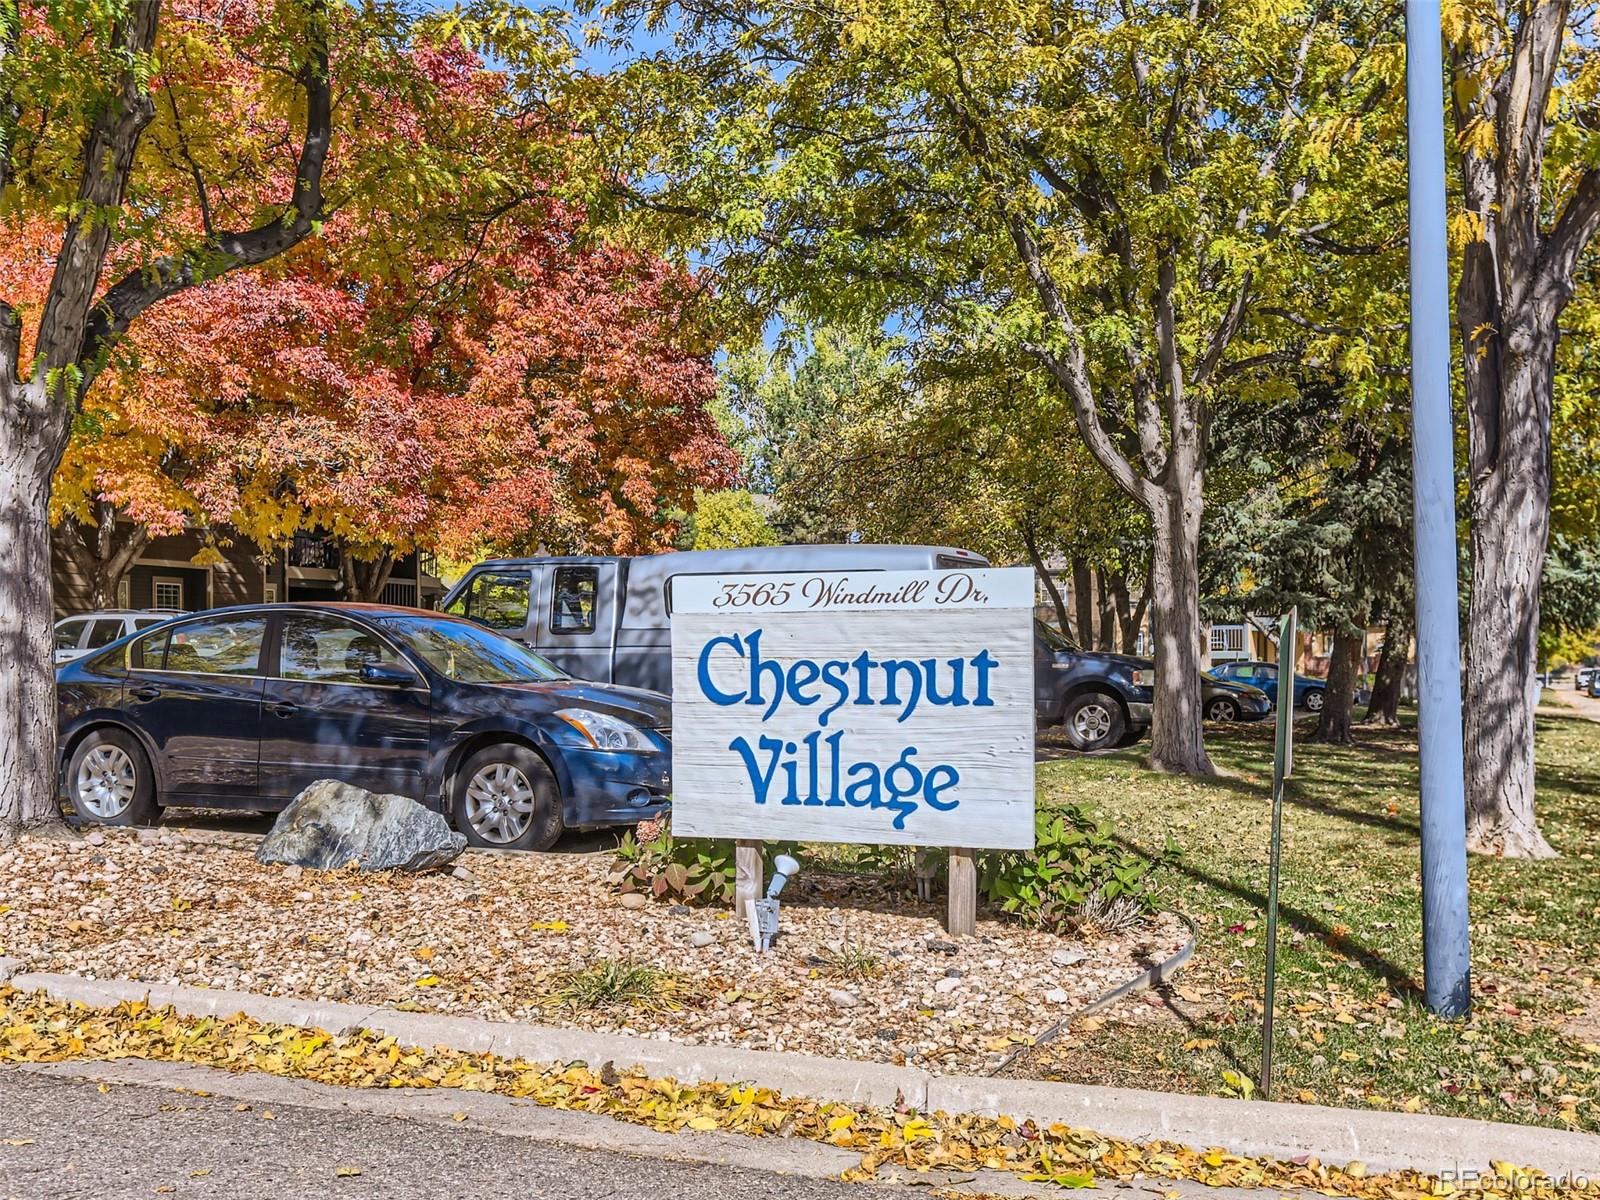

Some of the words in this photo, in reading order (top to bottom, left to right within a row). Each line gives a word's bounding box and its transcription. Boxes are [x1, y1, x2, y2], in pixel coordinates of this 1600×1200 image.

[712, 582, 796, 609] 3565
[801, 576, 928, 608] Windmill
[697, 628, 999, 727] Chestnut
[728, 729, 960, 830] Village
